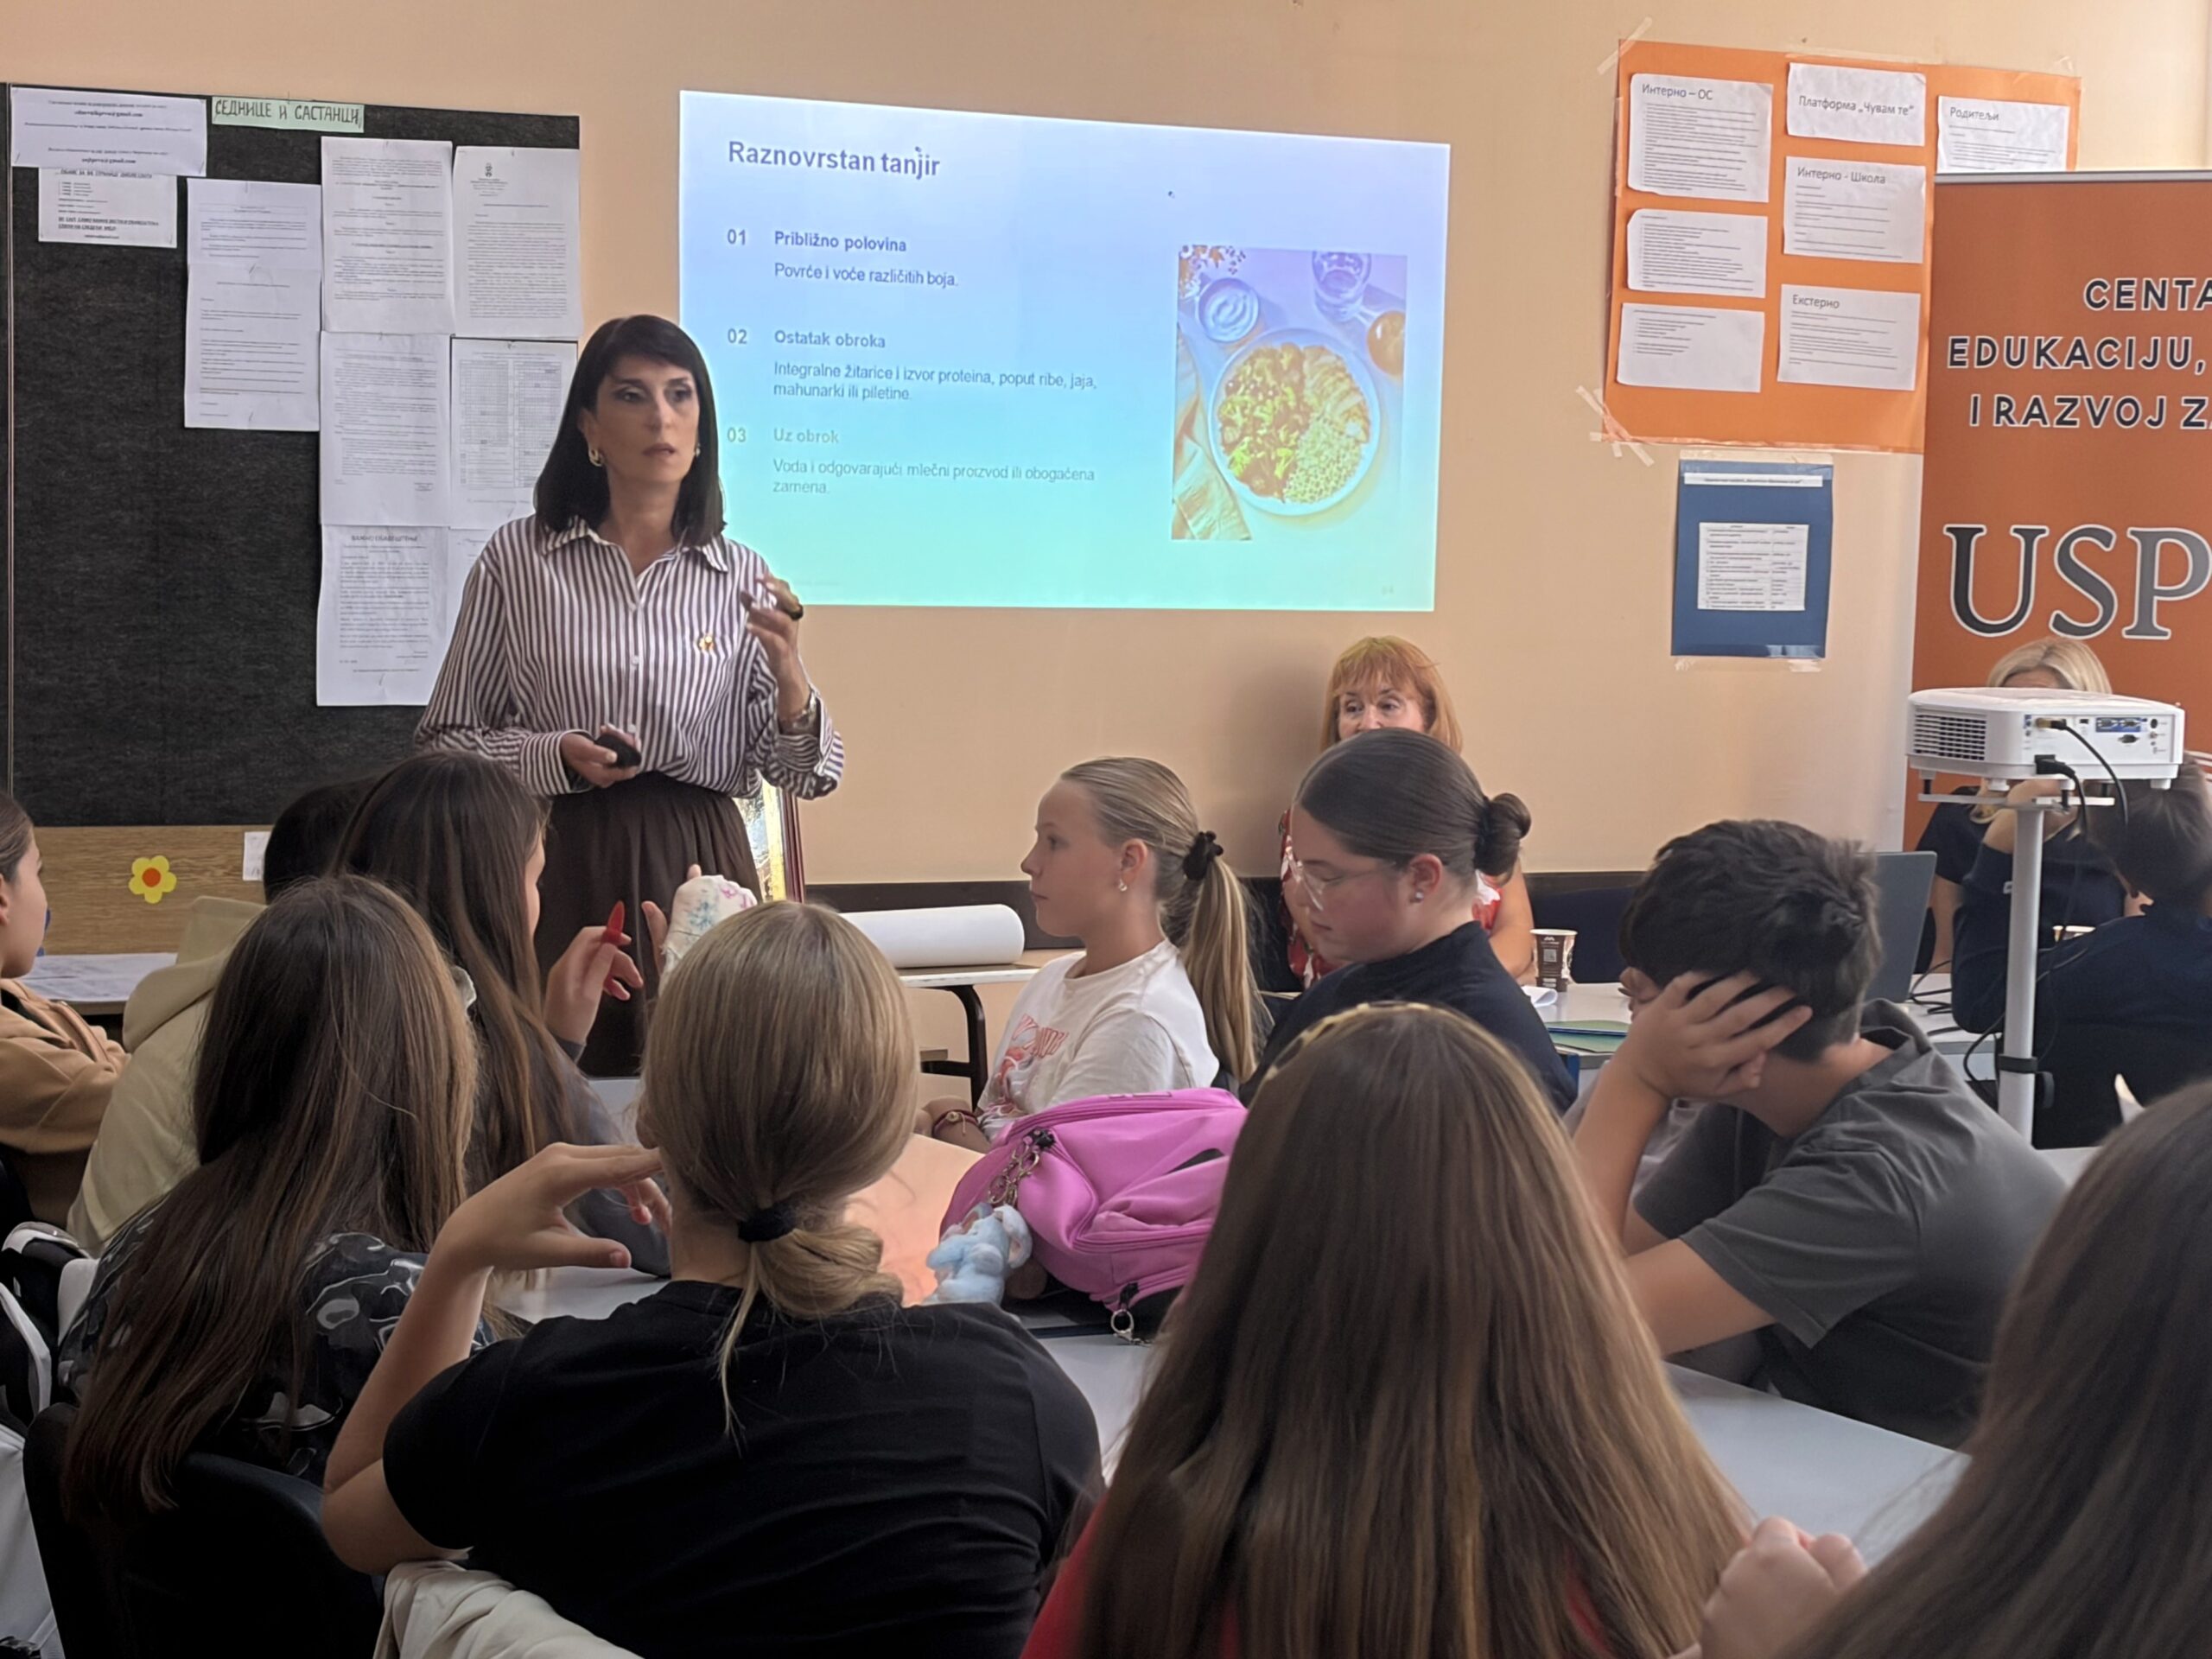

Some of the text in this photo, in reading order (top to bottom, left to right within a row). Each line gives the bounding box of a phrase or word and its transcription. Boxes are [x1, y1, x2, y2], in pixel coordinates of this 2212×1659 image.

[1642, 83, 1687, 99] Интерно
[215, 99, 272, 118] СЕДНИЦЕ
[295, 105, 359, 124] САСТАНЦИ
[1799, 95, 1856, 113] Платформа
[1950, 106, 1999, 122] Родитељи
[728, 140, 941, 180] Raznovrstan tanjir
[1797, 166, 1842, 181] Интерно
[1851, 171, 1886, 185] Школа
[727, 229, 747, 245] 01
[774, 230, 906, 252] Približno polovina
[774, 262, 959, 289] Povrće i voće različitih boja.
[1792, 294, 1840, 309] Екстерно
[728, 328, 747, 345] 02
[774, 330, 886, 348] Ostatak obroka
[1947, 336, 2206, 375] EDUKACIJU,
[774, 361, 841, 379] Integralne
[844, 364, 893, 380] žitarice
[904, 366, 935, 381] izvor
[938, 369, 995, 385] proteina,
[999, 372, 1035, 387] poput
[1039, 372, 1067, 389] ribe,
[1071, 373, 1097, 390] jaja,
[773, 382, 844, 398] mahunarki
[848, 384, 859, 398] ili
[1969, 394, 2212, 429] I RAZVOJ Z
[727, 427, 747, 443] 03
[773, 428, 839, 444] Uz obrok
[772, 459, 808, 474] Voda
[818, 461, 902, 478] odgovarajući
[907, 463, 950, 477] mlečni
[953, 464, 1009, 480] proizvod
[1012, 466, 1022, 480] ili
[1025, 466, 1095, 483] obogaćena
[1942, 524, 2212, 640] USP
